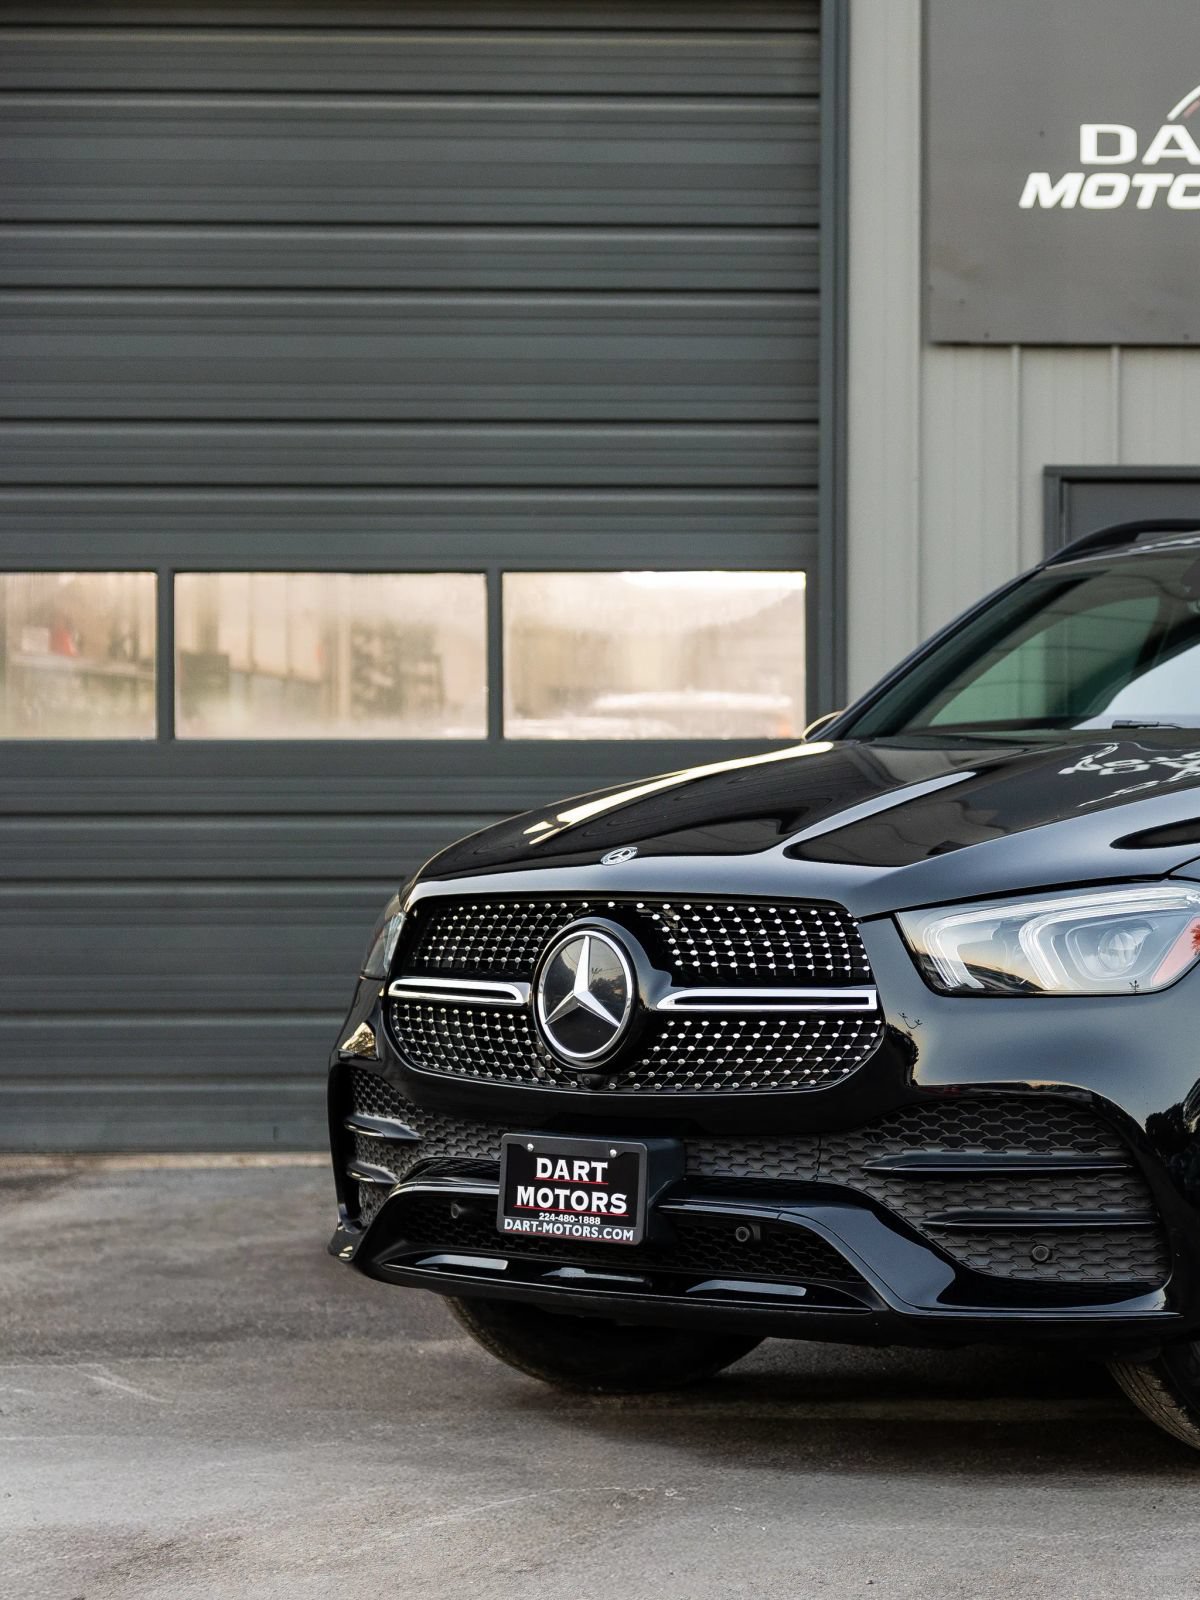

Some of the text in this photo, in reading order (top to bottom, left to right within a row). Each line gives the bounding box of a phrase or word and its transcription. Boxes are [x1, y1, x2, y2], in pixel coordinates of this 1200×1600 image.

[536, 1157, 609, 1183] DART
[516, 1185, 627, 1215] MOTORS
[503, 1218, 634, 1241] DART-MOTORS.COM
[538, 1212, 601, 1225] 224-480-1888
